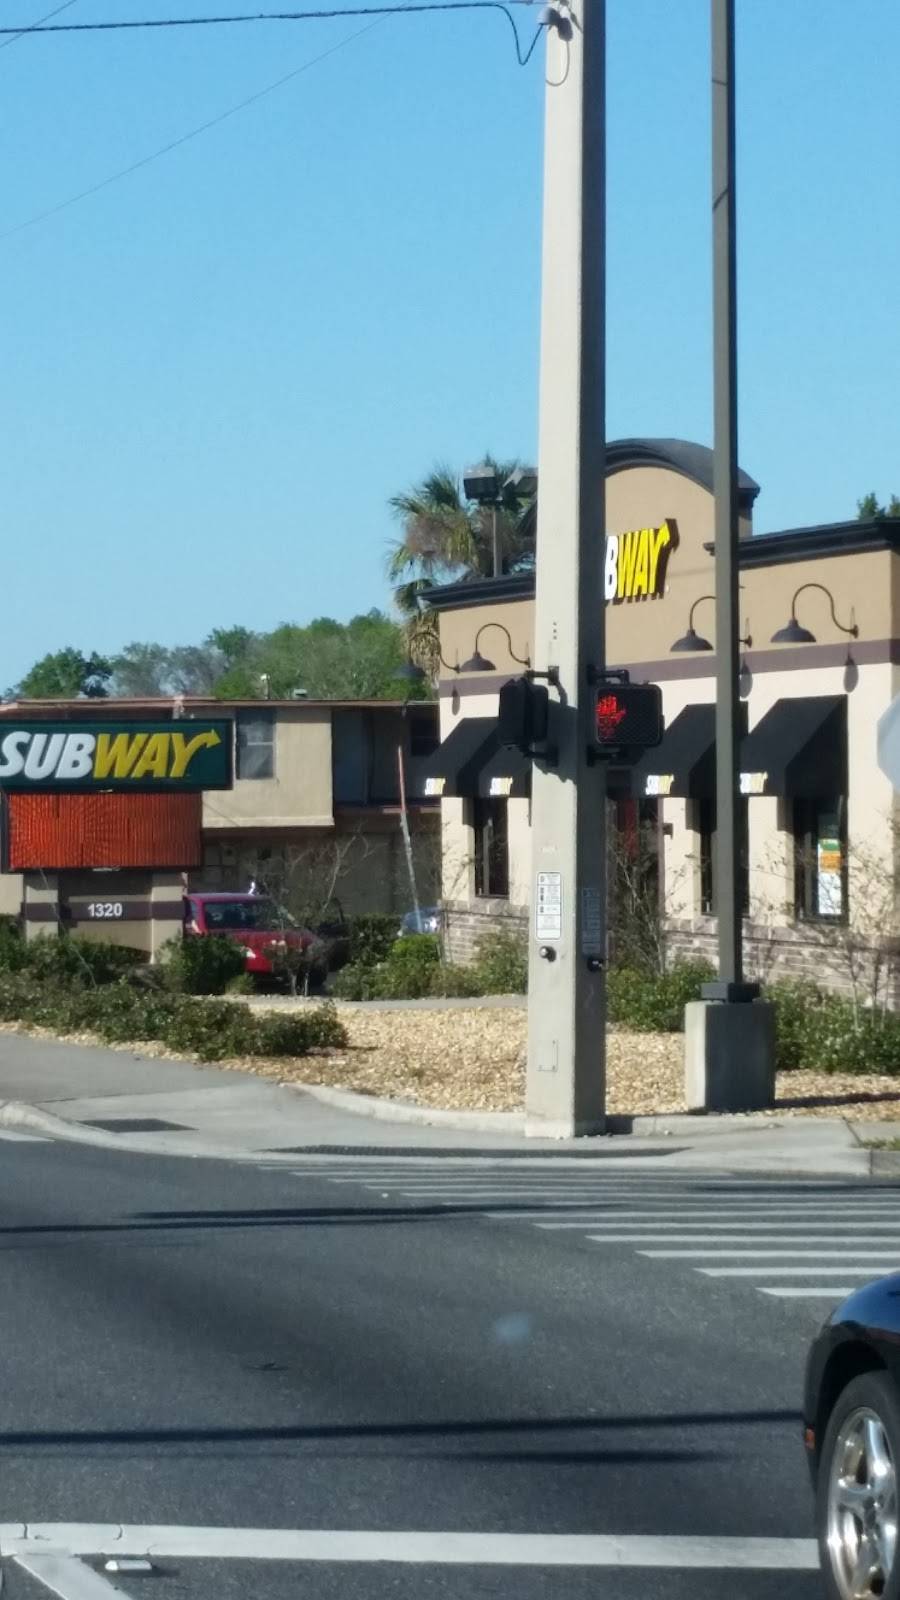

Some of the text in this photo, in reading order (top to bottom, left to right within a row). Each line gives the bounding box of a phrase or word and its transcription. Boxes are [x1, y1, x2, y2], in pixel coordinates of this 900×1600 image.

[604, 522, 671, 600] BWAY
[0, 730, 221, 780] SUBWAY
[87, 903, 123, 918] 1320
